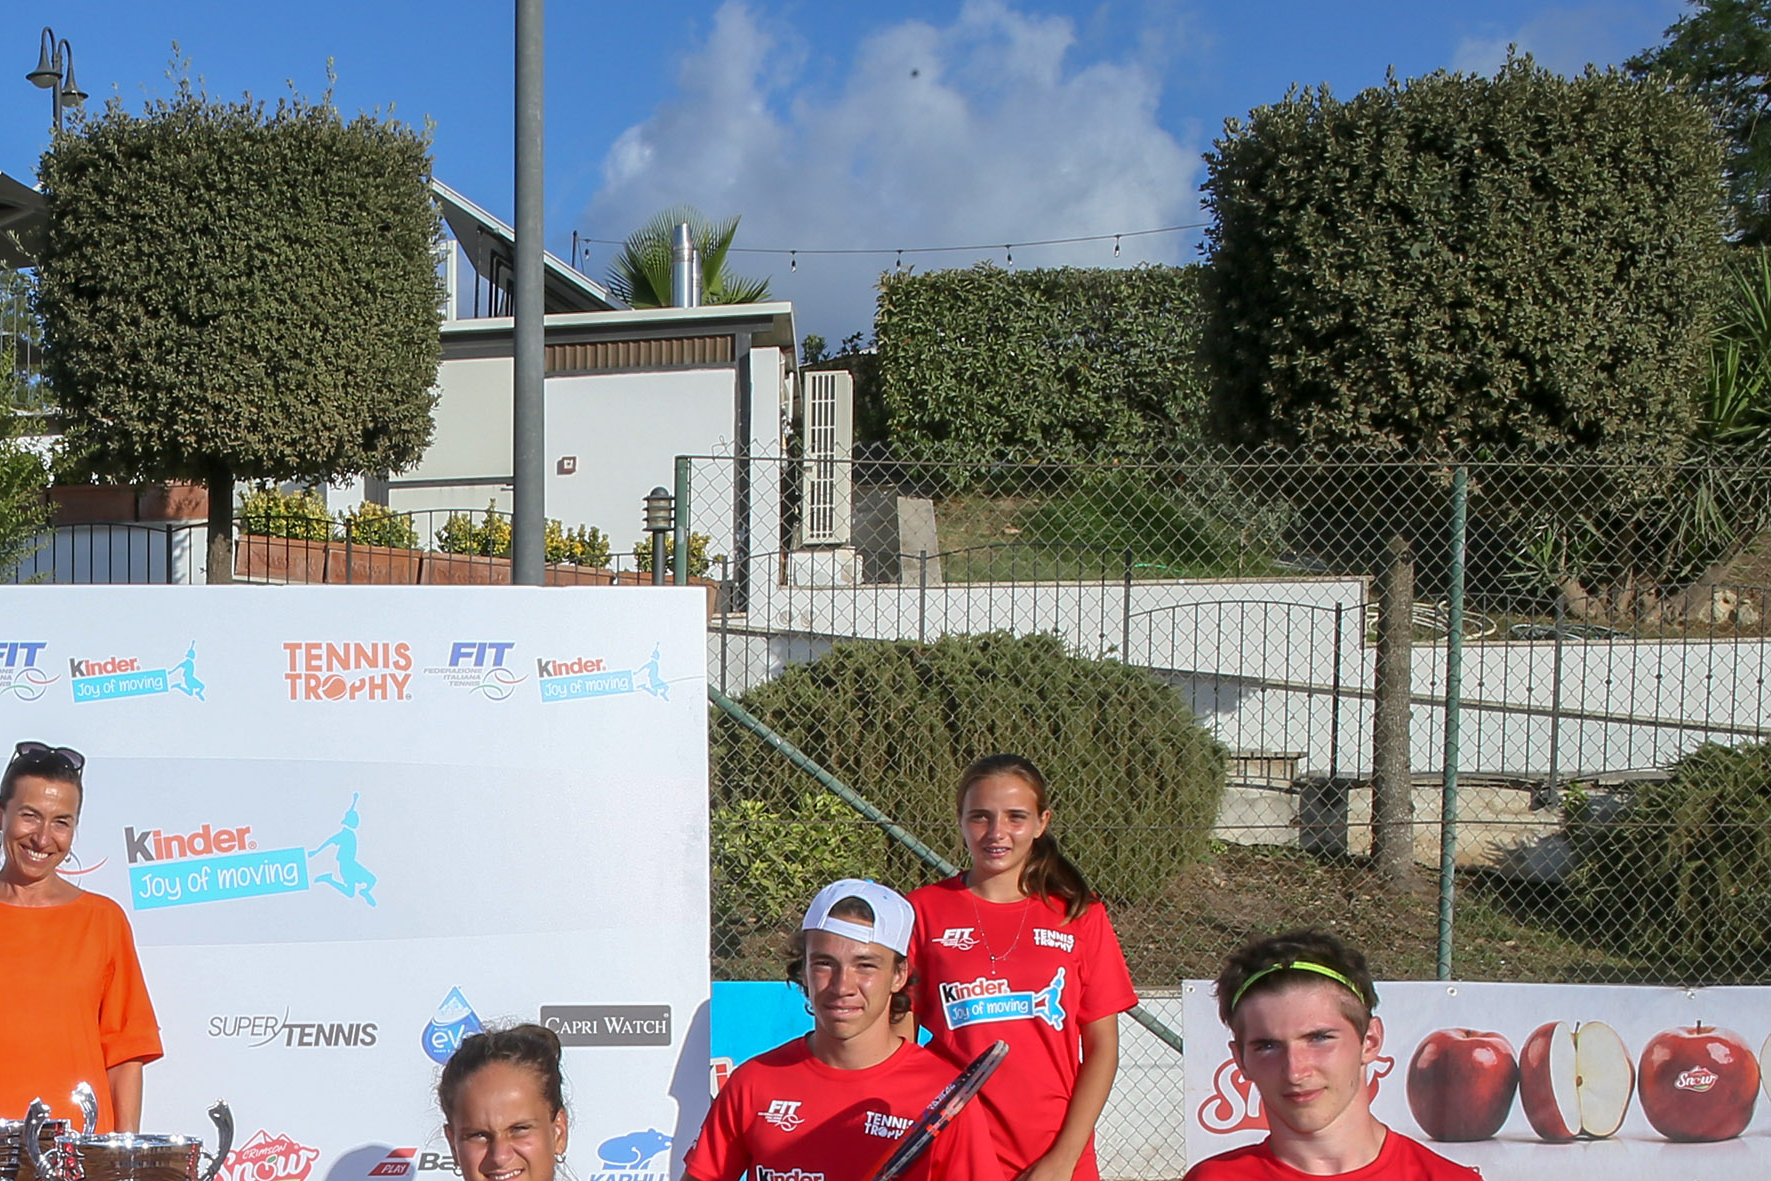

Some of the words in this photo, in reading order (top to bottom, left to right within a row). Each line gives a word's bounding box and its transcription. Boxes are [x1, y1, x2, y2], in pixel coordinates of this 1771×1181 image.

[283, 642, 413, 672] TENNIS
[448, 642, 515, 667] FIT
[69, 656, 138, 678] Kinder
[537, 657, 604, 678] Kinder
[77, 683, 100, 697] Joy
[103, 679, 117, 693] of
[119, 676, 164, 691] moving
[284, 673, 412, 700] TROPHY
[544, 683, 567, 697] Joy
[570, 679, 584, 693] of
[585, 676, 628, 692] moving
[124, 824, 251, 863] Kinder
[139, 873, 181, 900] Joy
[187, 865, 211, 892] of
[217, 859, 299, 889] moving
[943, 928, 974, 939] FIT
[1033, 928, 1074, 944] TENNIS
[942, 981, 1004, 1003] Kinder
[952, 1007, 970, 1020] Joy
[971, 1001, 984, 1015] of
[987, 998, 1028, 1013] moving
[208, 1016, 279, 1037] SUPER
[283, 1023, 378, 1047] TENNIS
[604, 1017, 667, 1034] WATCH
[1676, 1073, 1716, 1087] Snow
[768, 1100, 802, 1114] FIT
[242, 1143, 288, 1160] CRIMSON
[381, 1164, 406, 1174] PLAY
